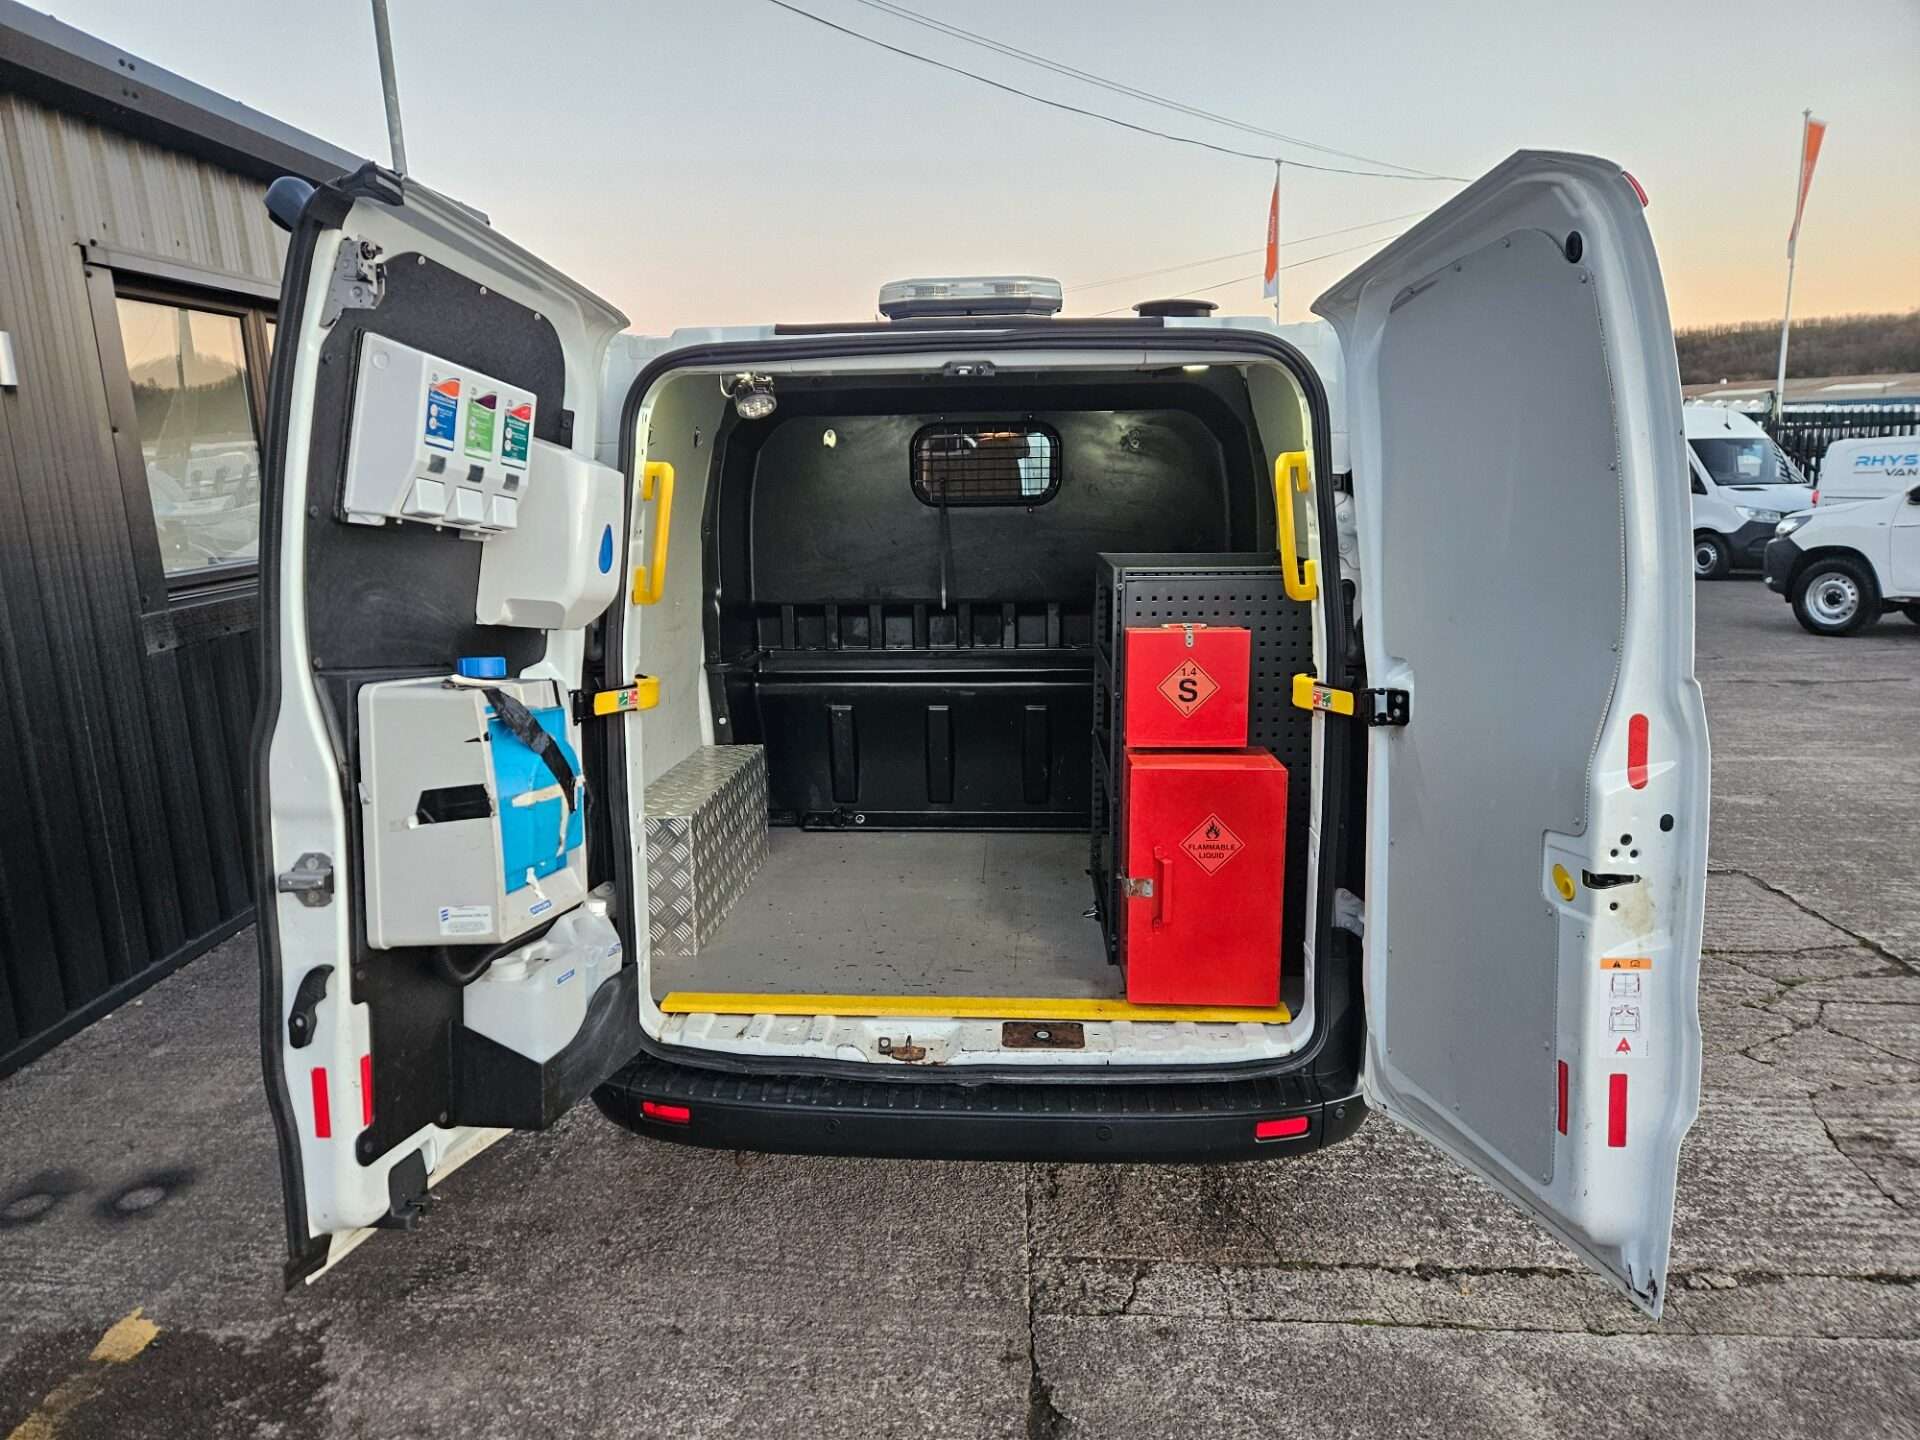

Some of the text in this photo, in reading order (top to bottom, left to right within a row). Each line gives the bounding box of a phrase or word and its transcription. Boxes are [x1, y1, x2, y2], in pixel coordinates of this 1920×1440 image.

[1855, 455, 1918, 466] RHYS
[1885, 468, 1918, 476] VAN
[1181, 667, 1197, 676] 1.4
[1178, 678, 1198, 703] S
